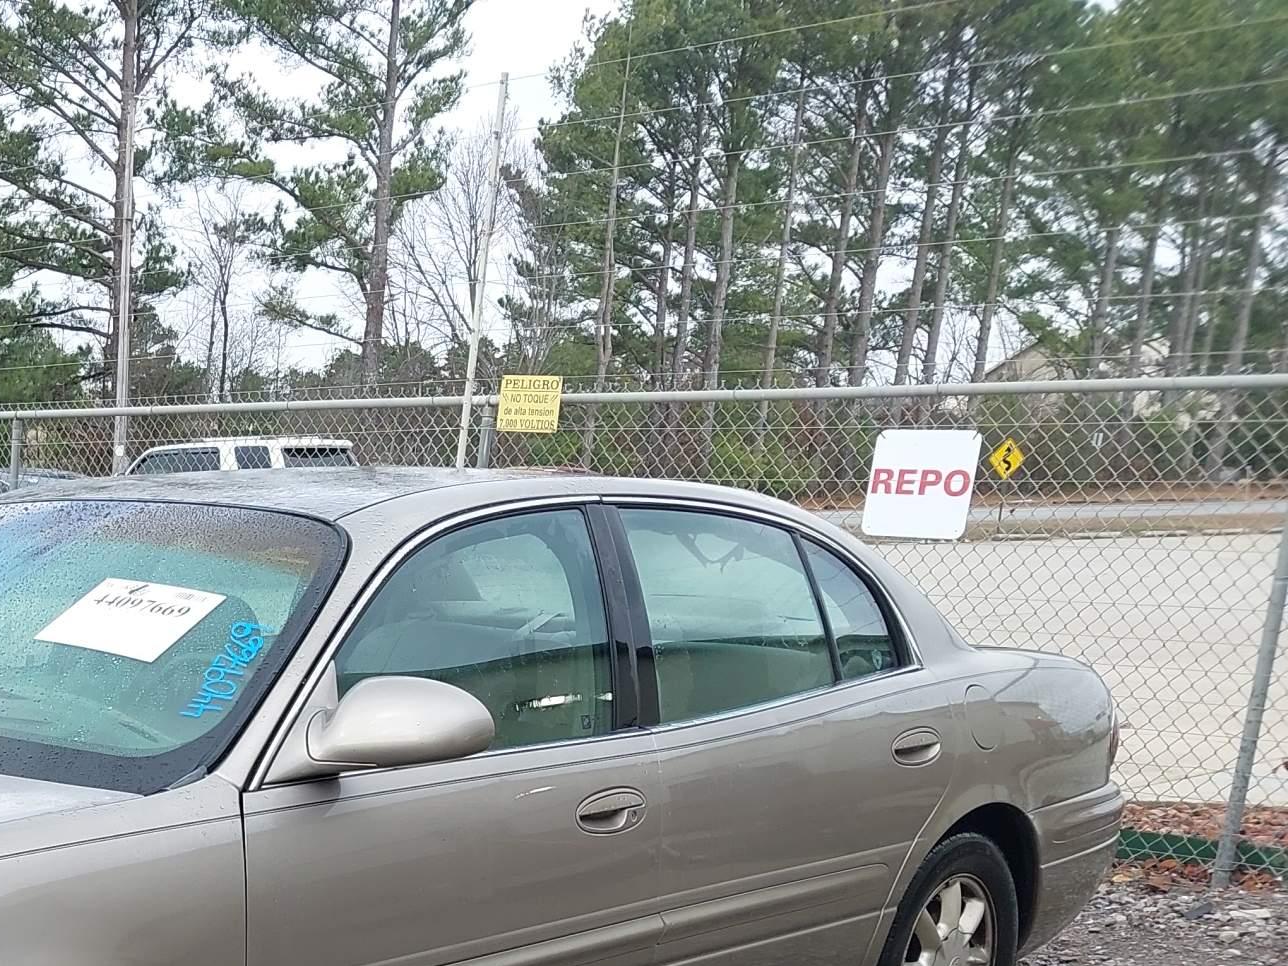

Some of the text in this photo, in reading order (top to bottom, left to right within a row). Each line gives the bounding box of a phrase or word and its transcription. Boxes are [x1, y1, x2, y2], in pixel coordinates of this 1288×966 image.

[504, 378, 560, 390] PELIGRO
[510, 393, 549, 404] NO TOQUE
[503, 406, 555, 417] de alta tension
[519, 419, 556, 430] VOLTIOS
[871, 468, 971, 497] REPO
[93, 593, 192, 618] 44097669
